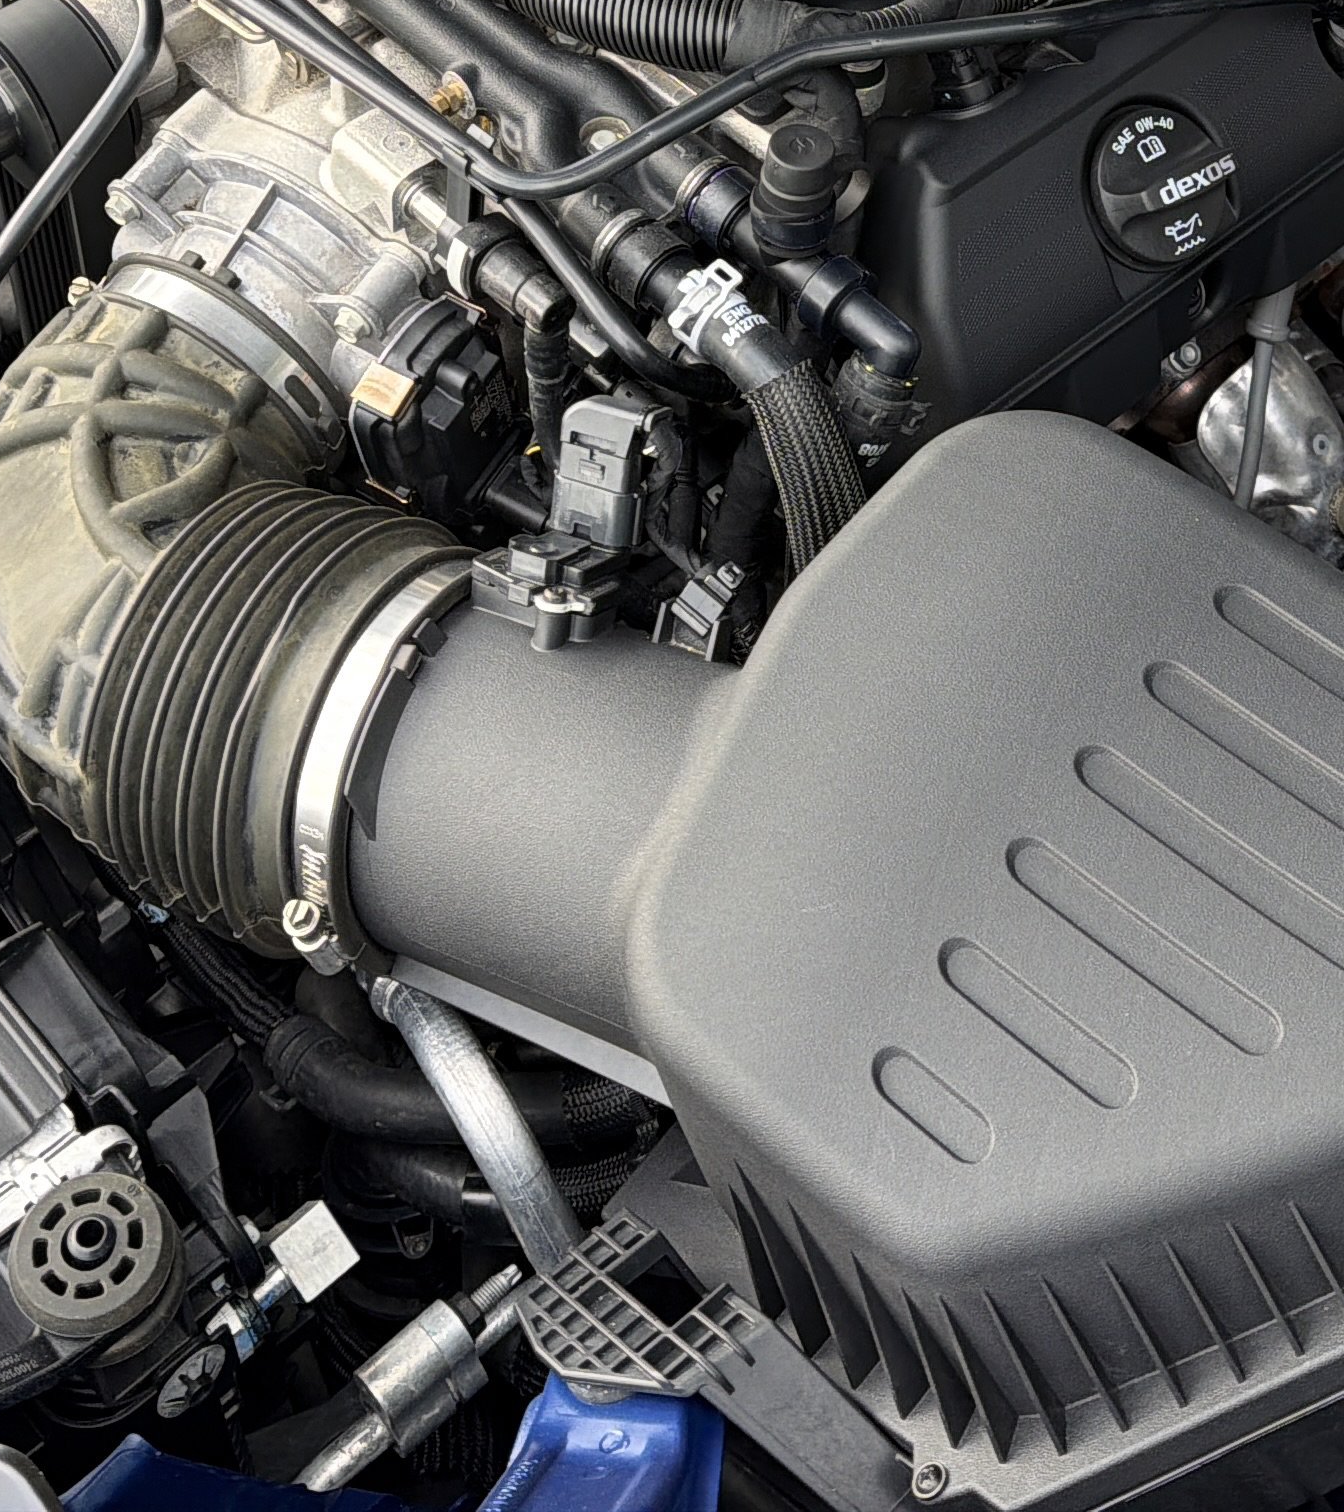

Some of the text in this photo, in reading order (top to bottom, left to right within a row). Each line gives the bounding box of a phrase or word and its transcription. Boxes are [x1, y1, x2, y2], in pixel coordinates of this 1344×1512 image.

[1112, 116, 1174, 155] SAE 0W-40
[1159, 152, 1236, 205] dexos
[721, 303, 753, 326] ENG
